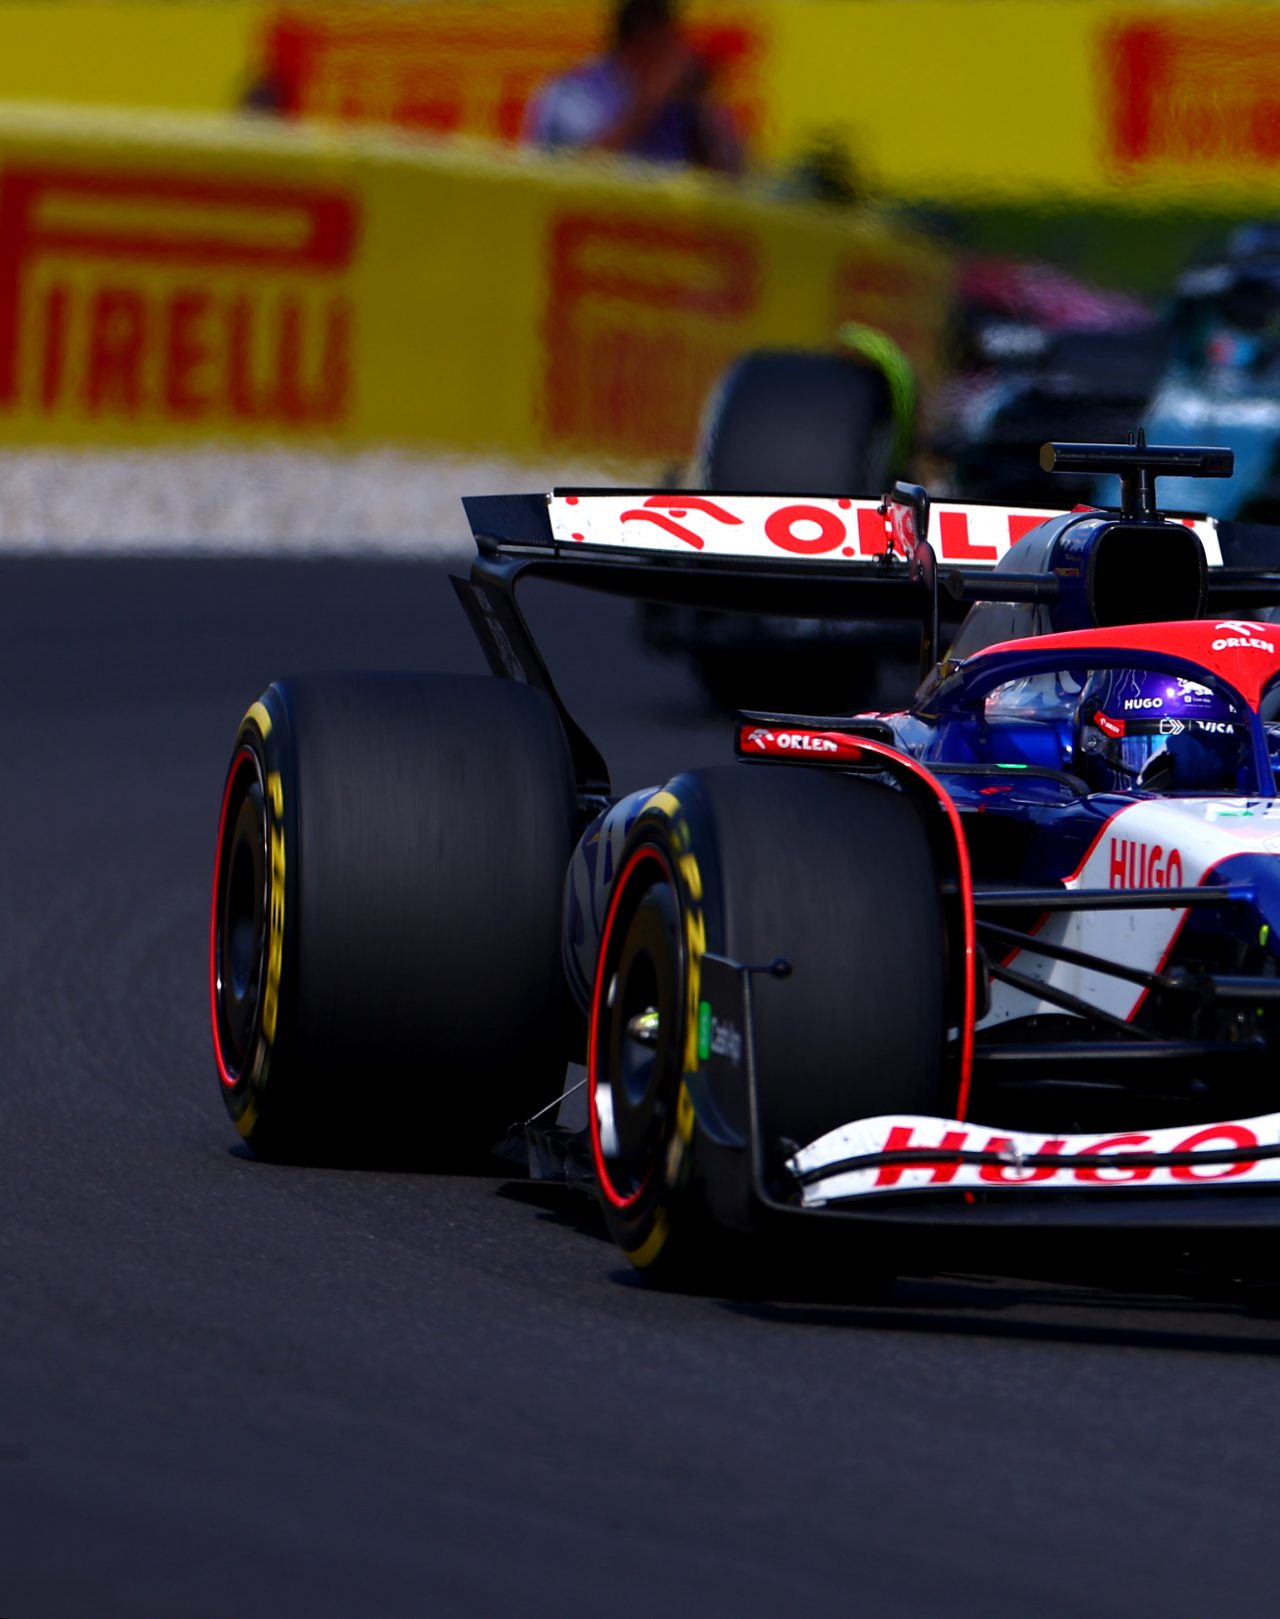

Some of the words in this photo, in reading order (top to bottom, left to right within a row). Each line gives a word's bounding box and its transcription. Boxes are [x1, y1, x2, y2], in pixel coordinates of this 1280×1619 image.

[1211, 637, 1275, 654] ORLEN
[1124, 697, 1163, 711] HUGO
[776, 733, 838, 753] ORLEN
[1109, 837, 1183, 889] HUGO
[874, 1123, 1259, 1188] HUGO
